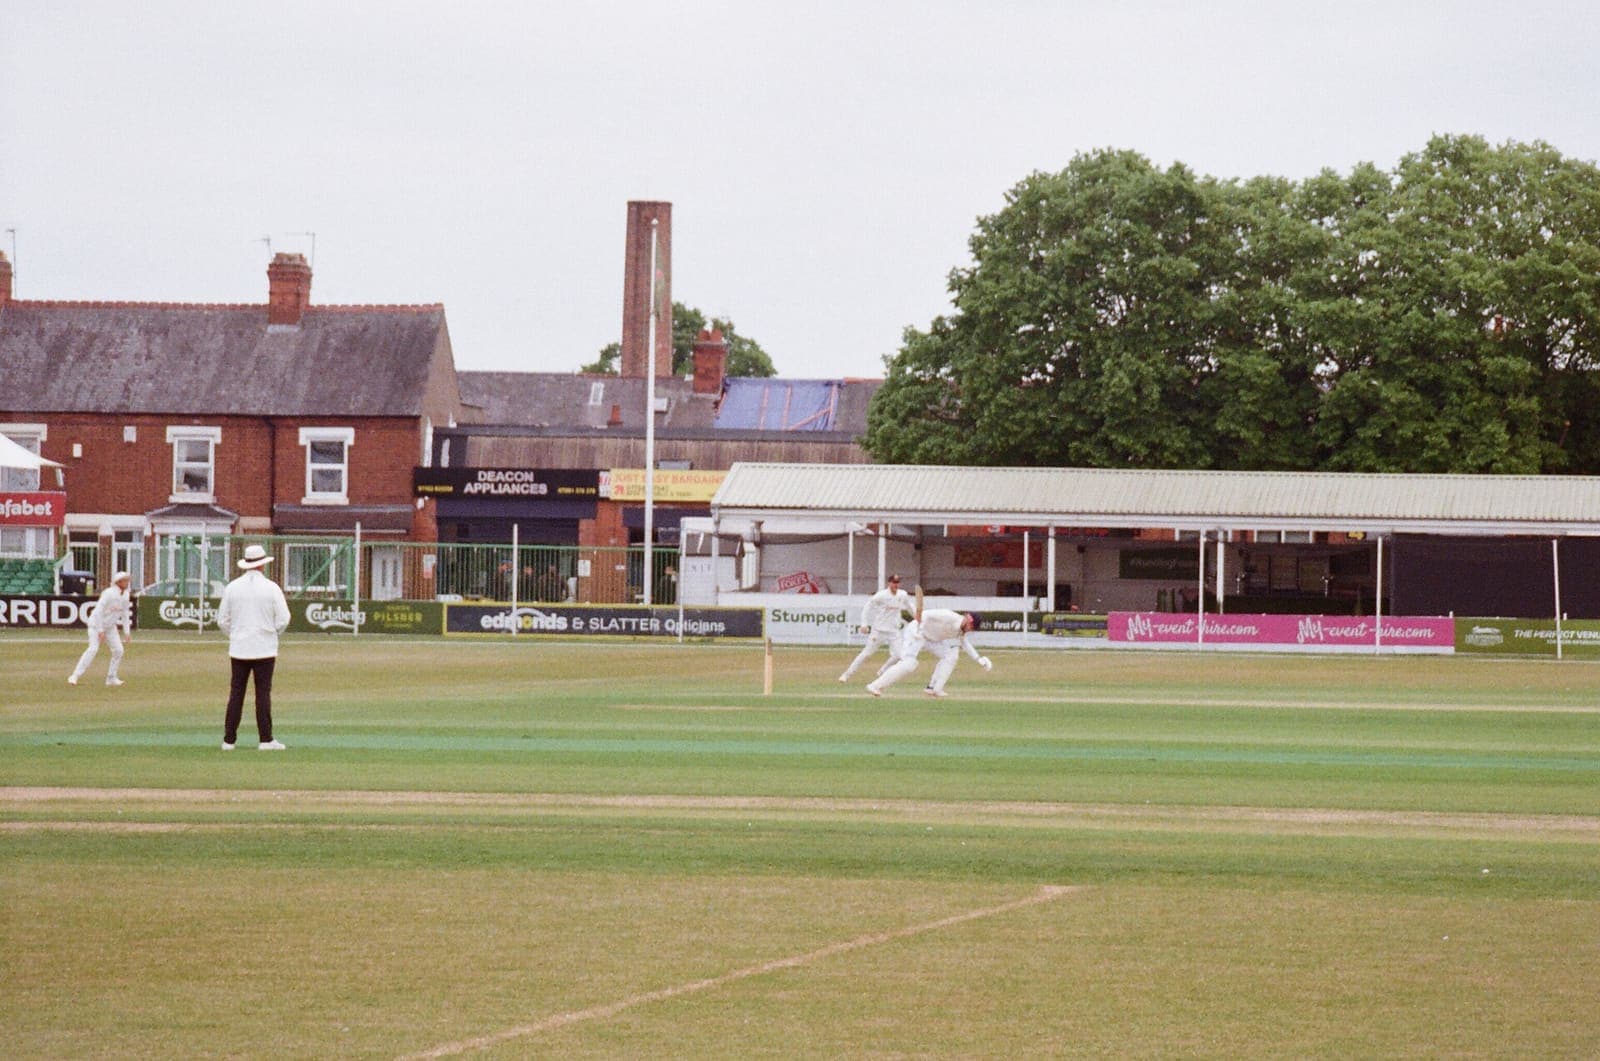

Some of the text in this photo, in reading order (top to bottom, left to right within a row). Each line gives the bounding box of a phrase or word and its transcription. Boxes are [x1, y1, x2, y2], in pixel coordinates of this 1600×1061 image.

[477, 470, 535, 482] DEACON
[463, 482, 548, 495] APPLIANCES
[0, 599, 133, 625] RID
[771, 609, 846, 626] Stumped
[480, 612, 725, 633] edmonds & SLATTER Opticians
[1514, 629, 1533, 638] THE
[1533, 630, 1575, 639] PERFCT
